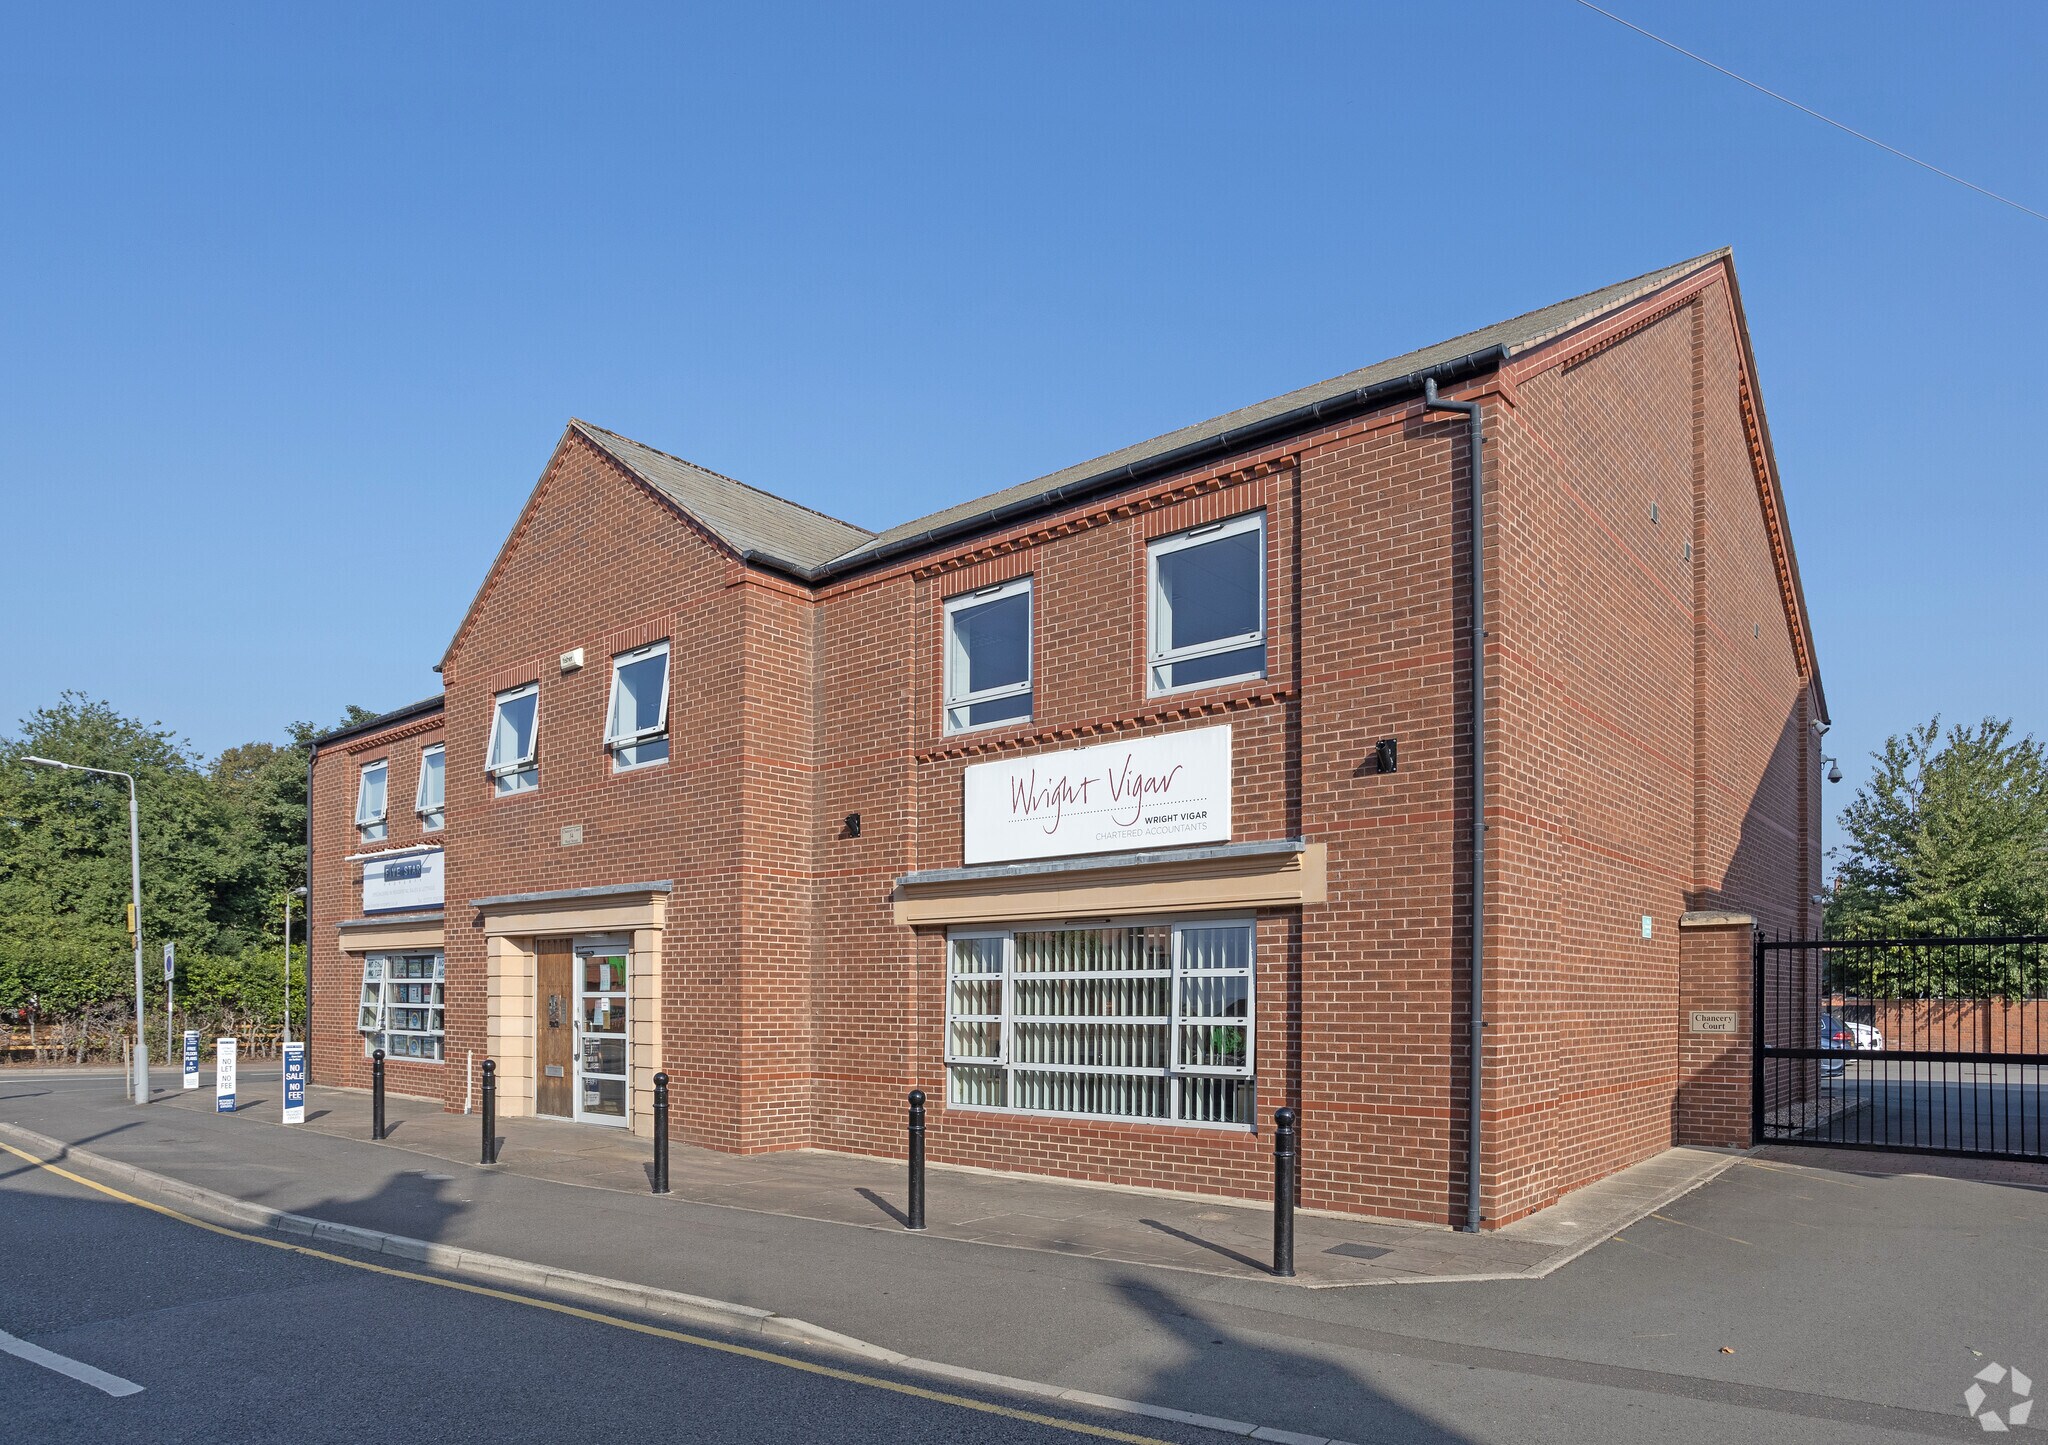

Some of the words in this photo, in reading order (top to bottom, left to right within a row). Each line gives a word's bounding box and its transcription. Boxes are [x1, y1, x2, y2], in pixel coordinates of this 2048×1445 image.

[1011, 768, 1100, 834] Wright
[1109, 754, 1183, 827] Vigar
[1144, 814, 1178, 825] WRIGHT
[1180, 810, 1208, 821] VIGAR
[1095, 828, 1143, 841] CHARTERED
[1145, 821, 1208, 836] ACCOUNTANTS
[385, 867, 401, 878] FIVE
[403, 864, 421, 876] STAR
[1695, 1014, 1733, 1024] Chancery
[1702, 1022, 1726, 1030] Court
[289, 1064, 300, 1072] NO
[285, 1072, 304, 1080] SALE
[289, 1083, 300, 1091] NO
